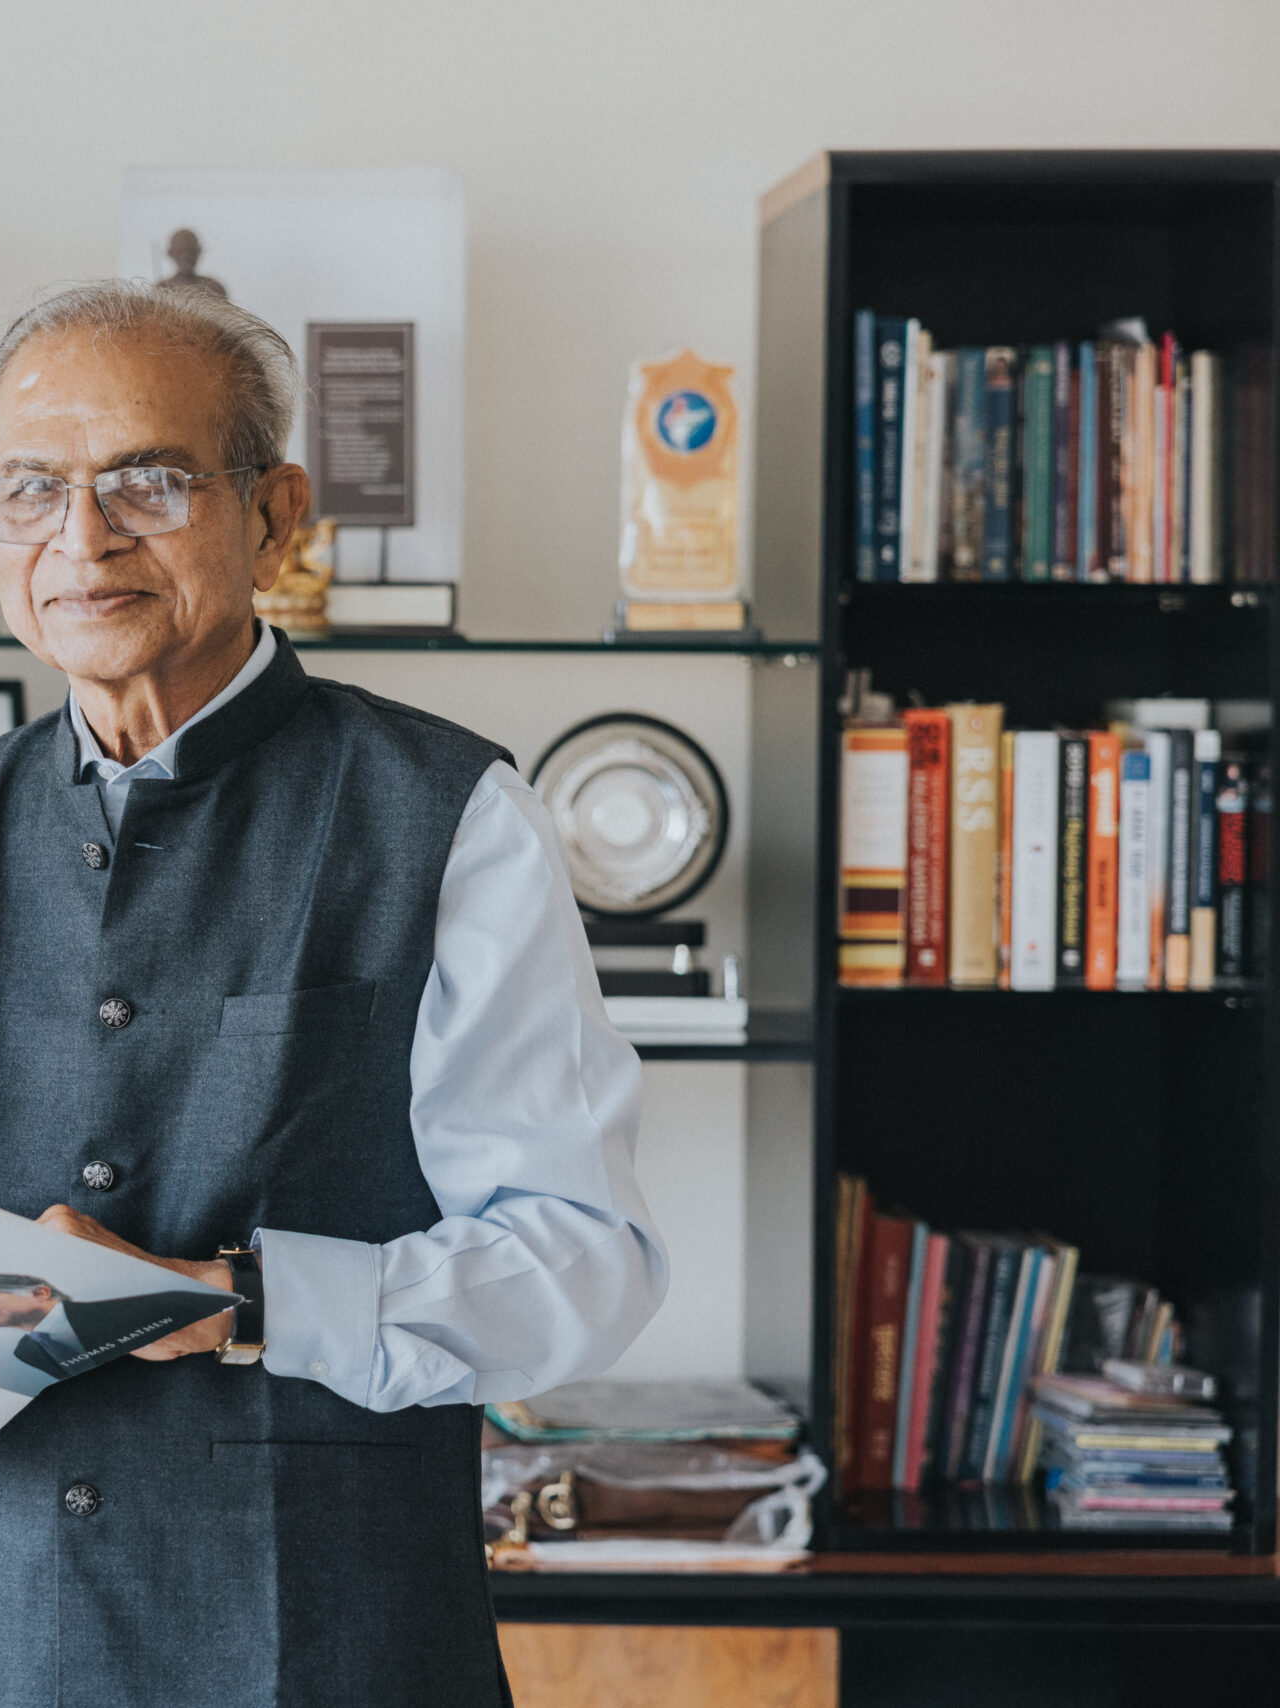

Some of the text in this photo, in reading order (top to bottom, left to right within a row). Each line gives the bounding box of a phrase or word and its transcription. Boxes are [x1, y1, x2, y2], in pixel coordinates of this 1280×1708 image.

[957, 746, 995, 833] RSS
[59, 1317, 174, 1368] THOMAS MATHEW
